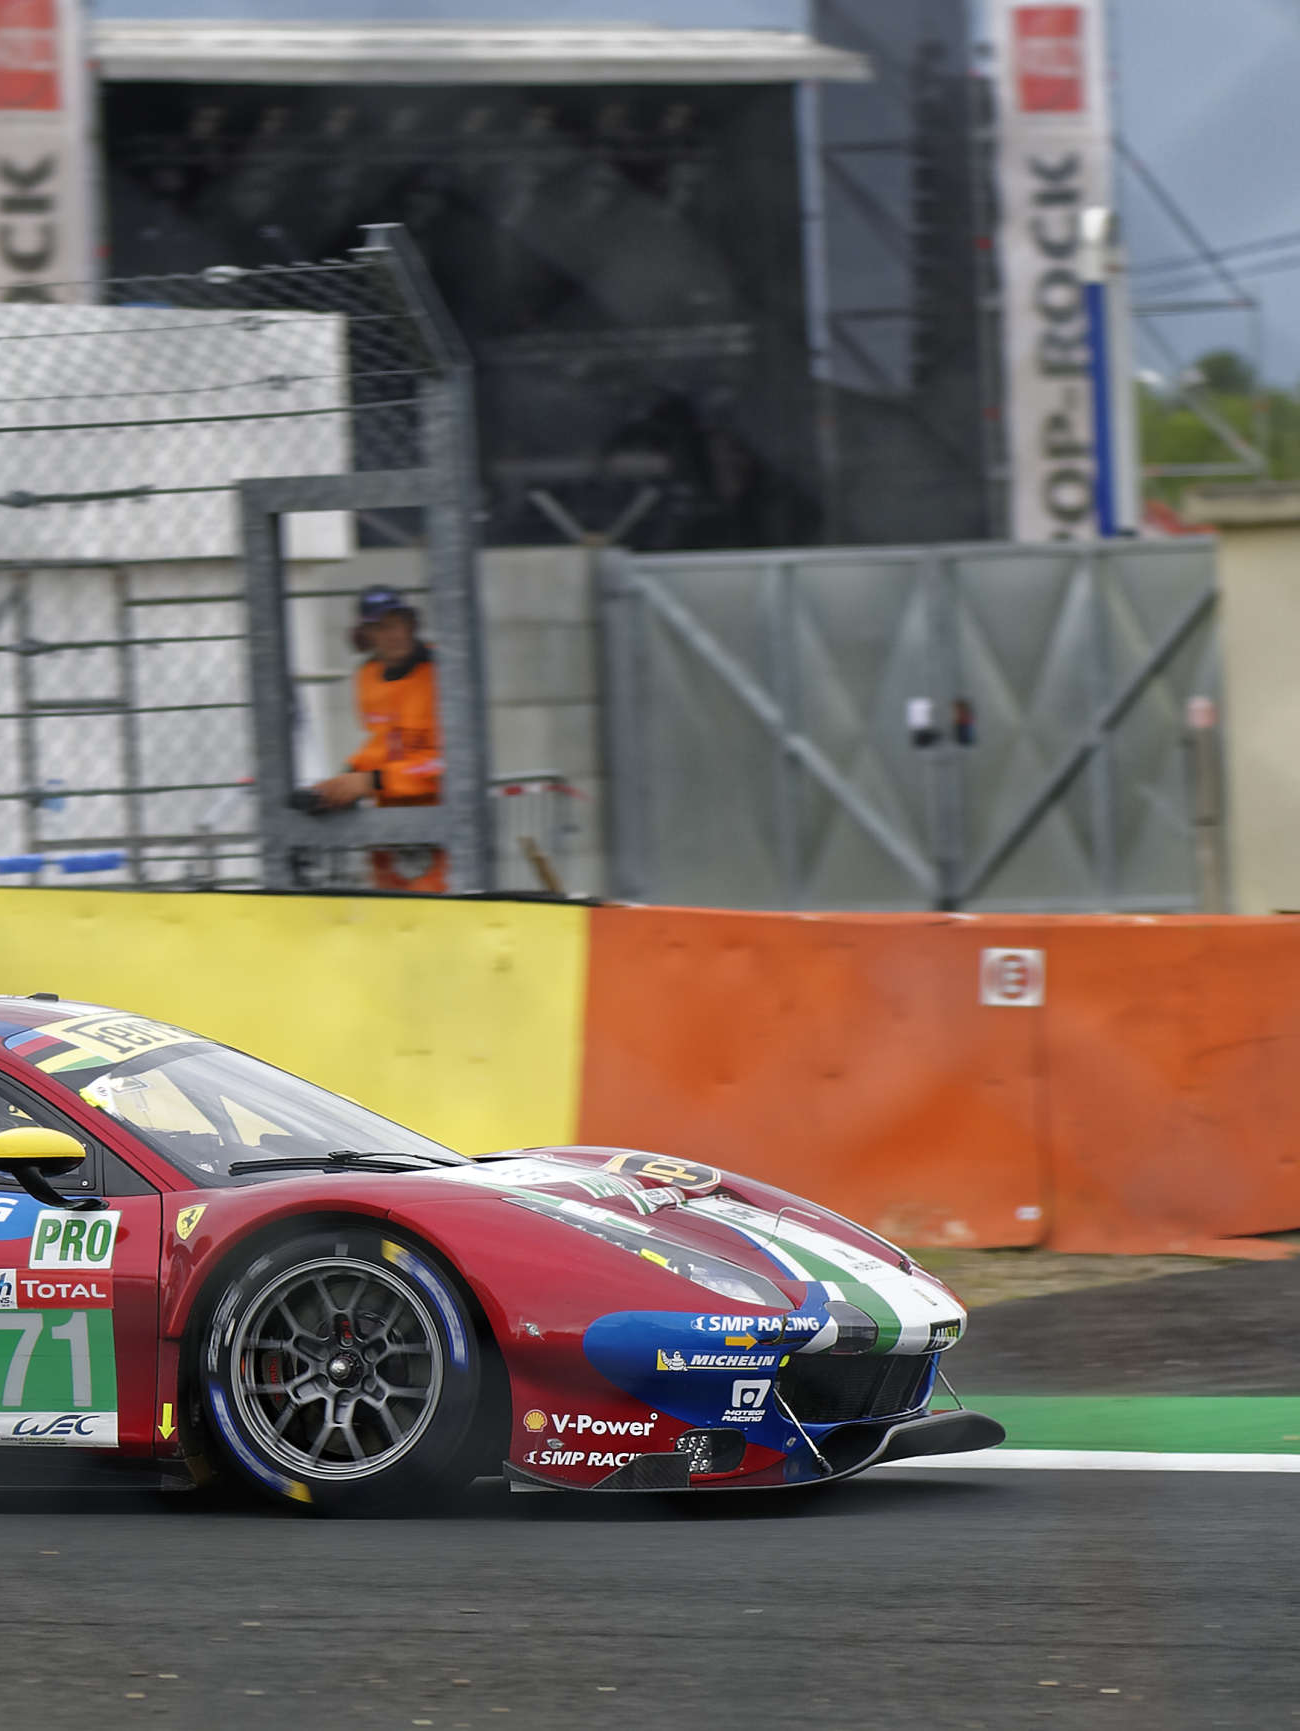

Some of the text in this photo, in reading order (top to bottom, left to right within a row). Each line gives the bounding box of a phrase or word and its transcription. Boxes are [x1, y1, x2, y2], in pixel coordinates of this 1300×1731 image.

[1030, 150, 1097, 540] OP-ROCK
[34, 1219, 113, 1262] PRO
[708, 1316, 820, 1331] SMP RACING
[690, 1354, 775, 1367] MICHELIN
[551, 1413, 657, 1436] V-Power
[538, 1450, 585, 1466] SMP
